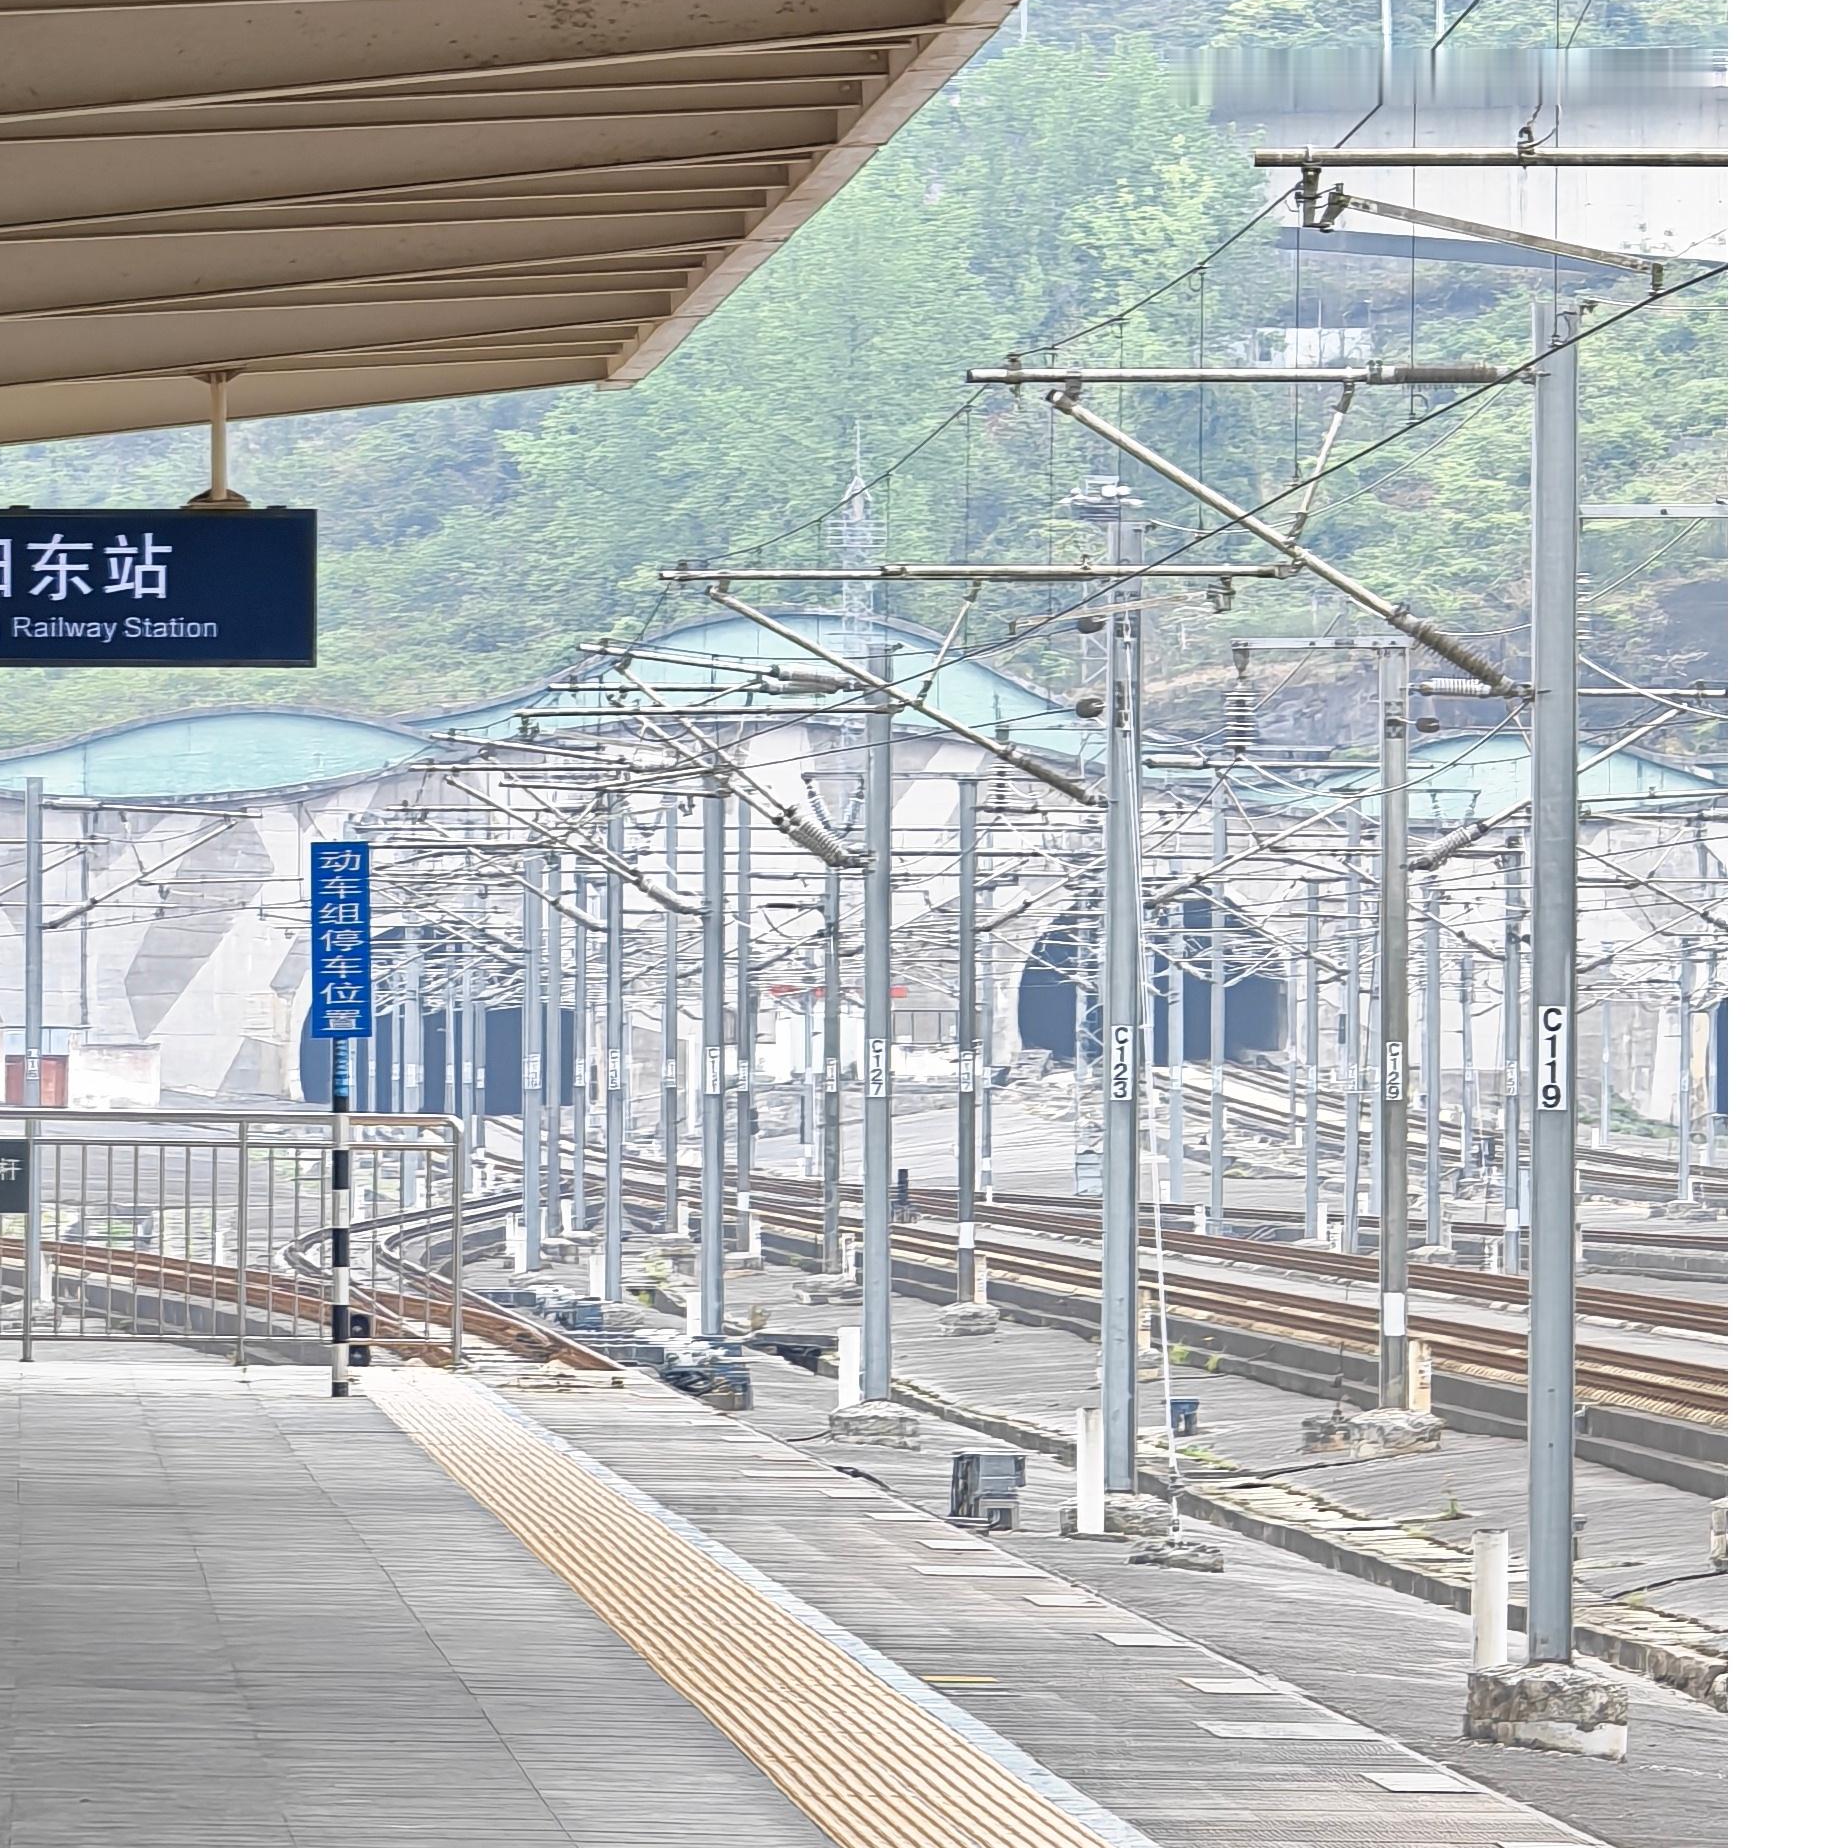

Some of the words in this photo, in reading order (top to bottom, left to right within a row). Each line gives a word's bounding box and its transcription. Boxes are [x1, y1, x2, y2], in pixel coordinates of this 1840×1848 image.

[13, 616, 117, 643] Railway
[124, 616, 217, 639] Station
[318, 849, 368, 1031] 动车组停车位置
[870, 1039, 884, 1095] C127
[1114, 1026, 1129, 1099] C123
[1386, 1042, 1400, 1099] C129
[1542, 1007, 1563, 1109] C119
